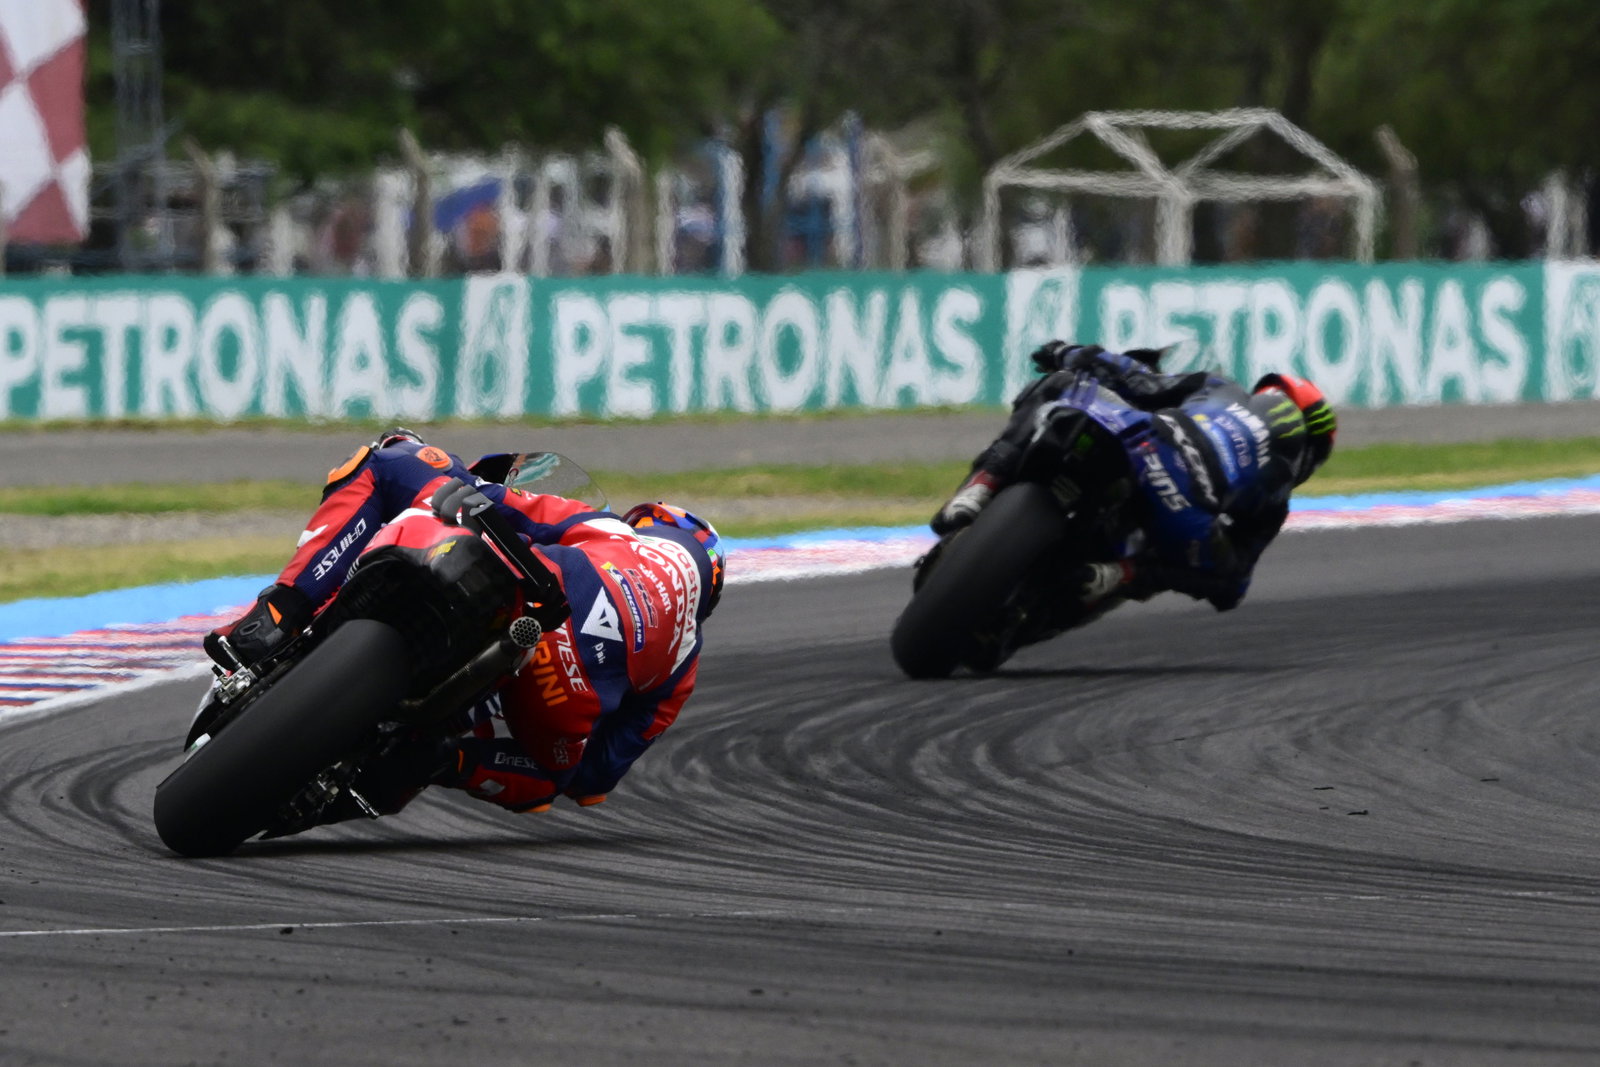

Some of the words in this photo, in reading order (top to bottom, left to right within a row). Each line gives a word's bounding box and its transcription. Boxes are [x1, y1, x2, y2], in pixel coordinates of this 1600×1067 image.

[0, 291, 446, 420] PETRONAS
[551, 287, 987, 418] PETRONAS
[1101, 278, 1528, 405] PETRONAS
[312, 518, 367, 581] DAINESE
[658, 541, 698, 633] Castrol
[622, 583, 642, 643] MICHELIN
